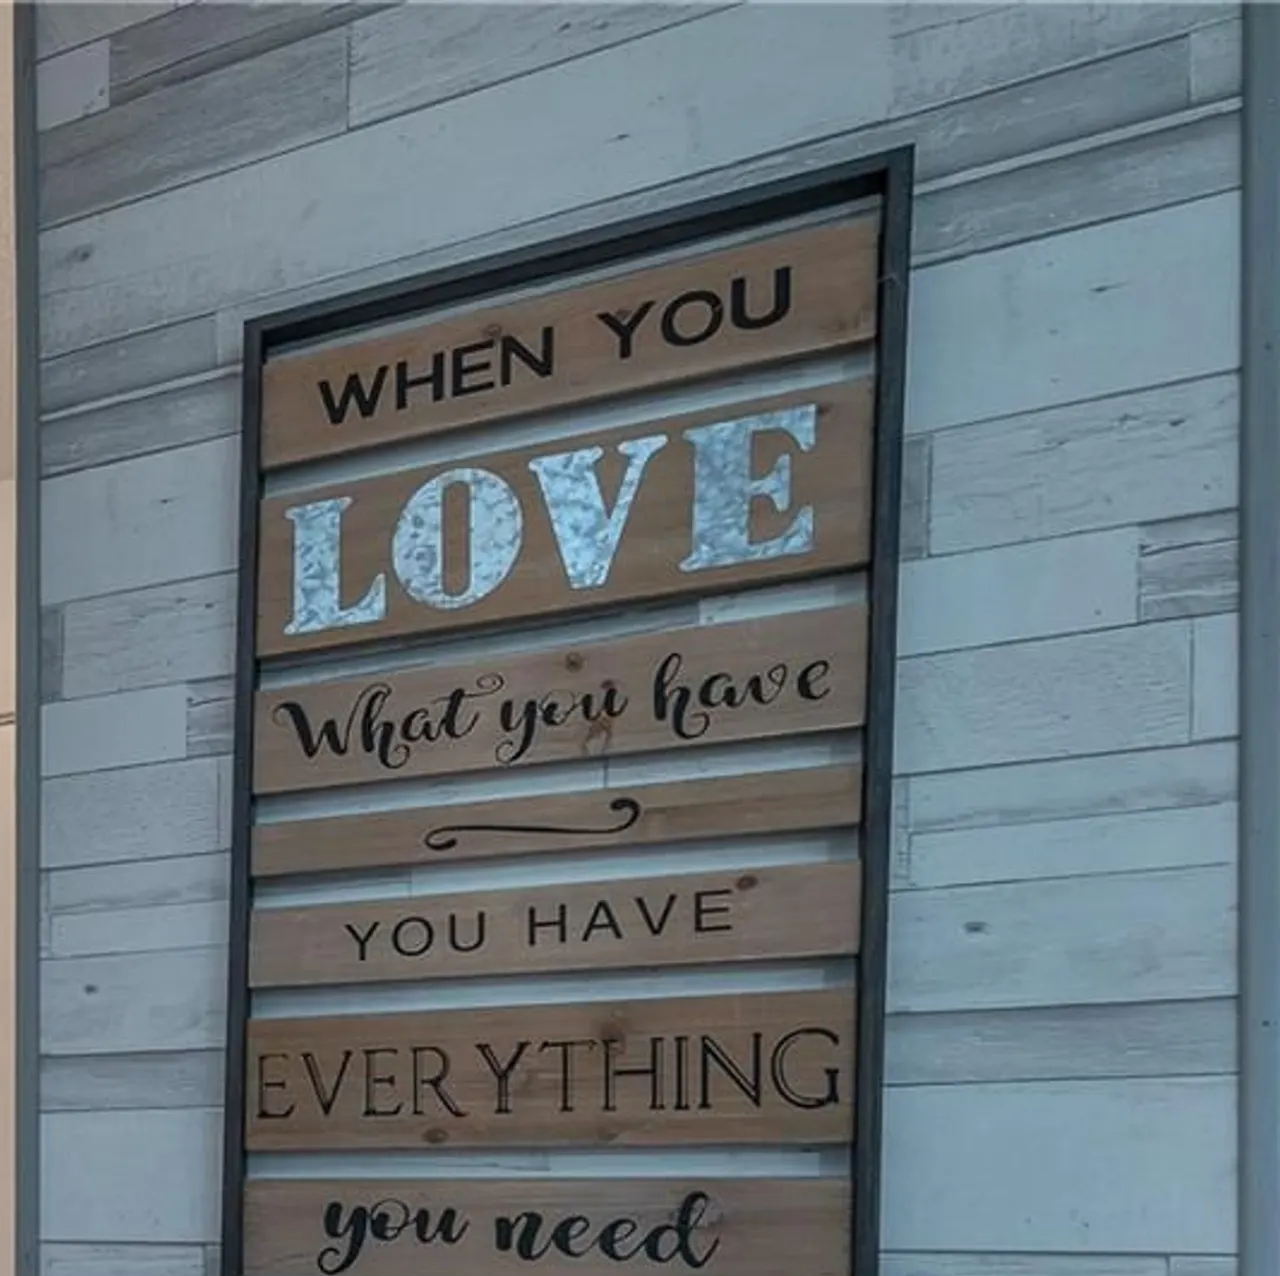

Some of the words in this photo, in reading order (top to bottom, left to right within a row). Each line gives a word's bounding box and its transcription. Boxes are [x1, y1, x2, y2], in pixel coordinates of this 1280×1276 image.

[318, 326, 556, 426] WHEN
[596, 265, 792, 360] YOU
[283, 403, 818, 636] LOVE
[272, 672, 504, 769] What
[495, 680, 628, 764] you
[653, 652, 832, 739] have
[344, 910, 487, 961] YOU
[526, 888, 736, 948] HAVE
[256, 1026, 840, 1120] EVERYTHING
[317, 1198, 469, 1276] you
[494, 1190, 721, 1269] need
